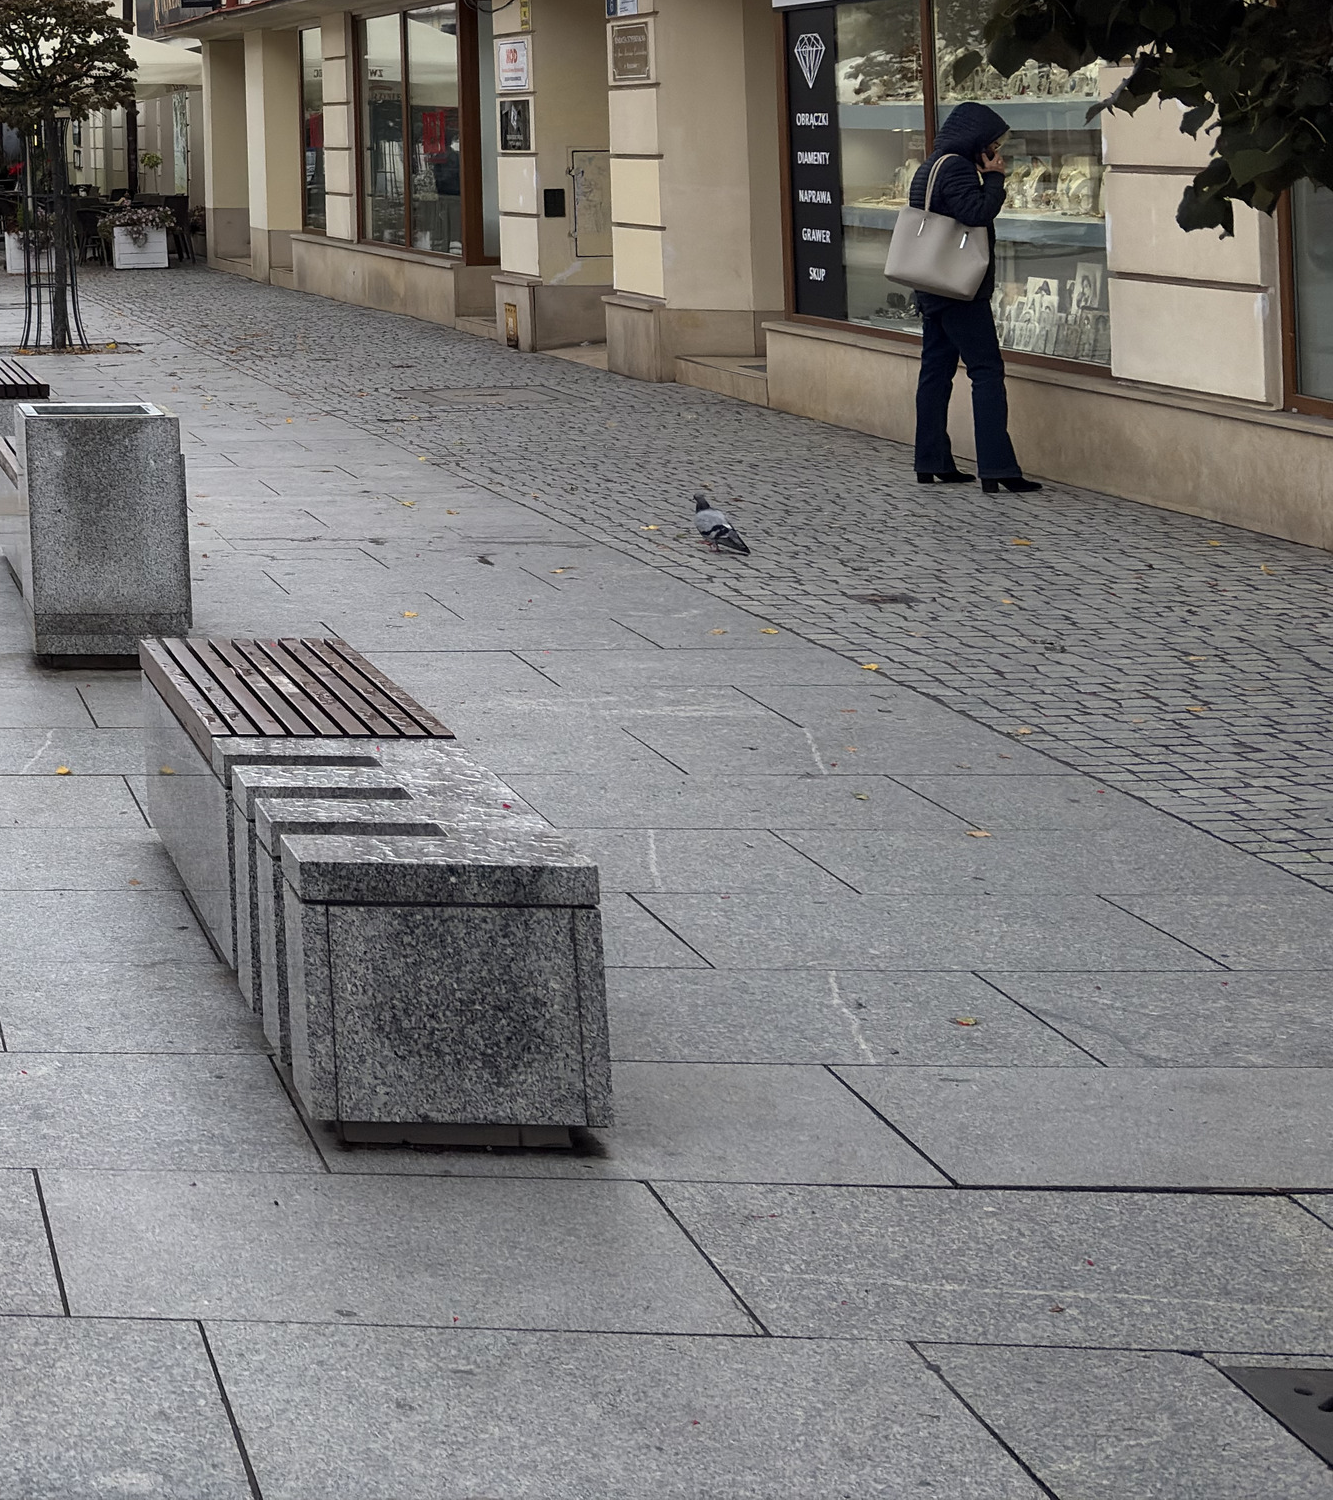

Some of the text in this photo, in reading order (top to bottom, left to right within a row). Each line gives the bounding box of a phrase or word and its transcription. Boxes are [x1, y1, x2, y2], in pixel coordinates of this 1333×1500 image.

[796, 113, 829, 129] OBRĄCZKI
[797, 152, 830, 165] DIAMENTY
[798, 190, 832, 204] NAPRAWA
[802, 228, 832, 244] GRAWER
[809, 267, 826, 282] SKUP
